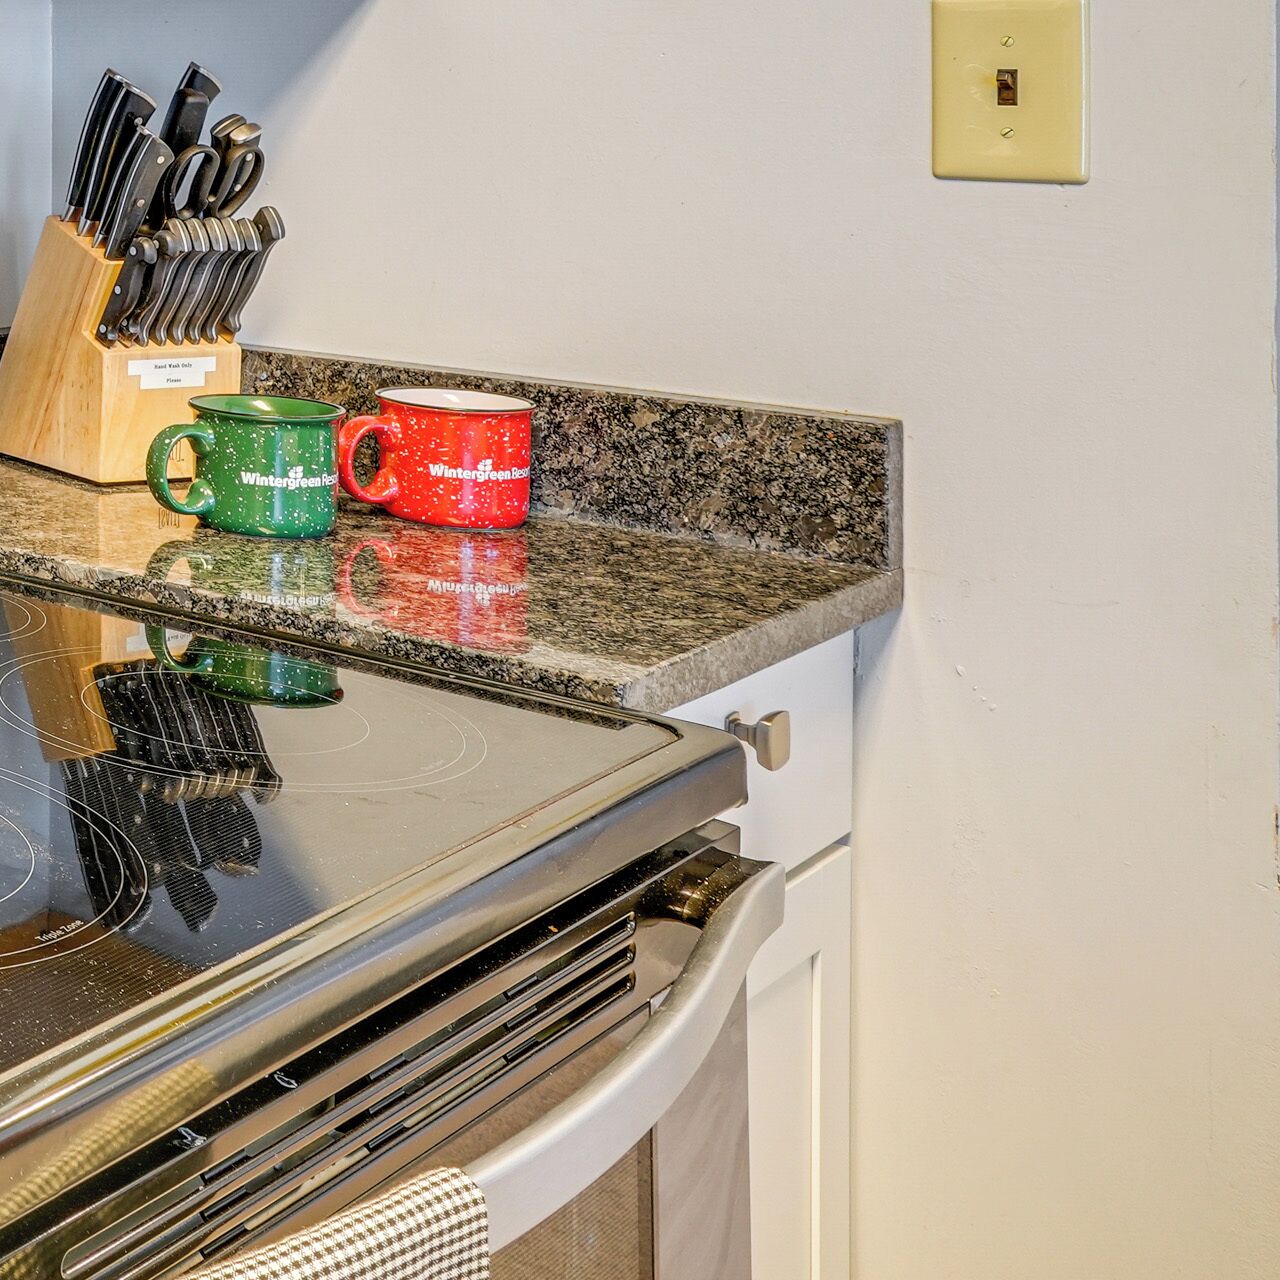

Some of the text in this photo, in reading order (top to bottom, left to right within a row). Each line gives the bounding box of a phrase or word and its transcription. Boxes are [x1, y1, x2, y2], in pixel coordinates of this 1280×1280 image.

[240, 469, 322, 490] Wintergreen
[428, 463, 511, 483] Wintergreen
[59, 919, 84, 932] Zone
